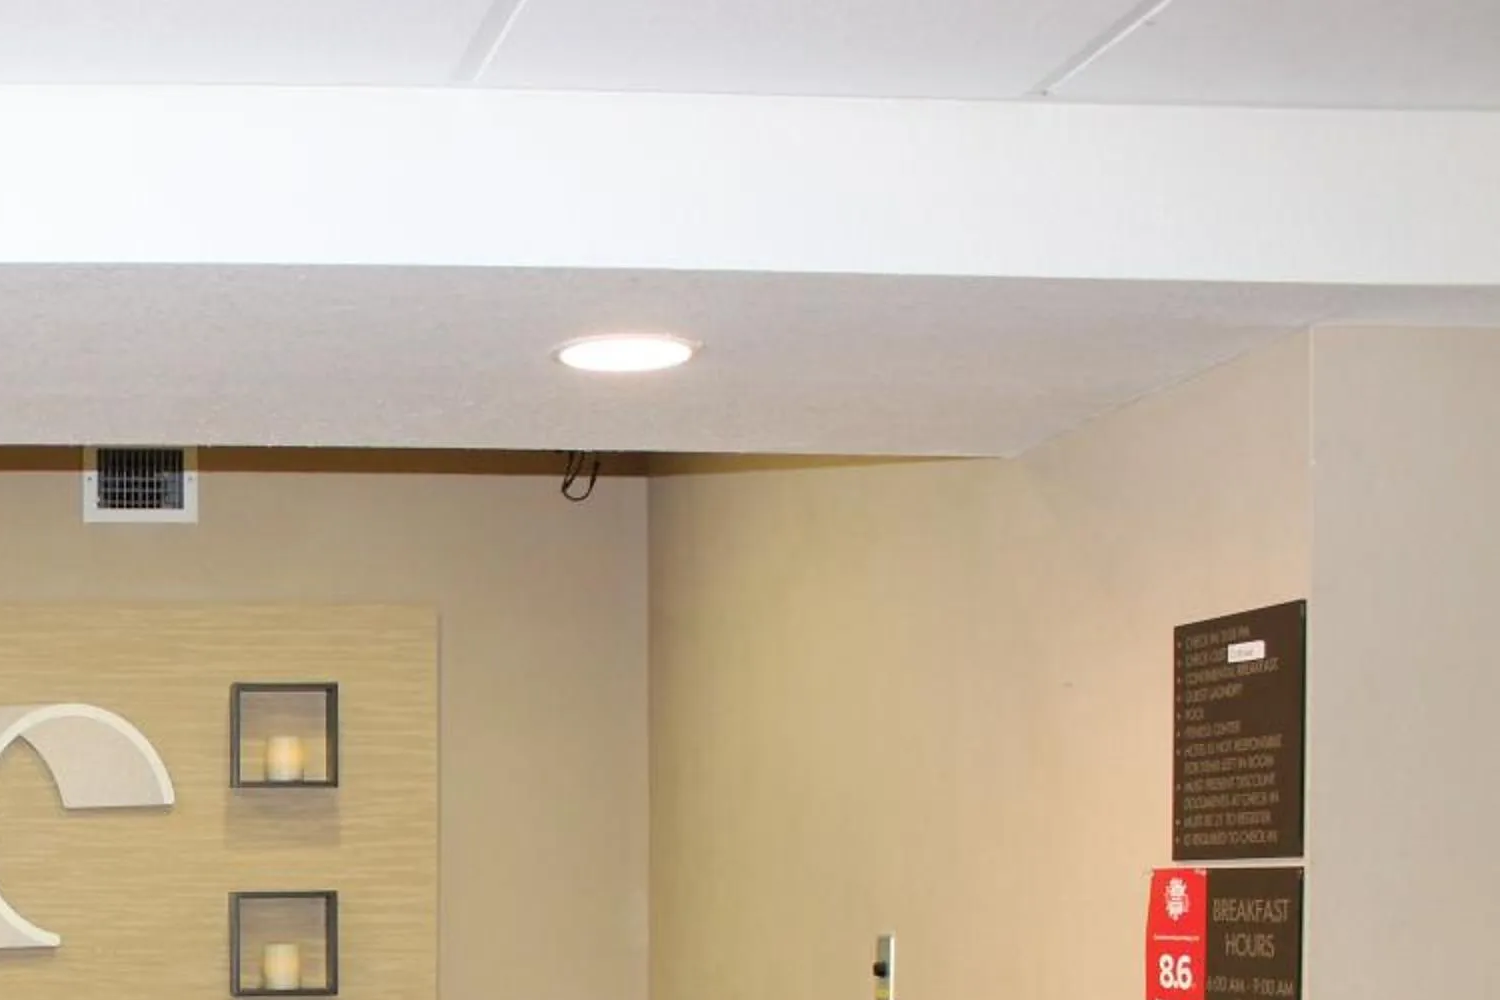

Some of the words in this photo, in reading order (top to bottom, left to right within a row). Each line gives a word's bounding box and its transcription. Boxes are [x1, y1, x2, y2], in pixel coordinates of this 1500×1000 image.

[1212, 897, 1291, 922] BREAKFAST
[1224, 932, 1275, 959] HOURS
[1159, 953, 1193, 990] 8.6
